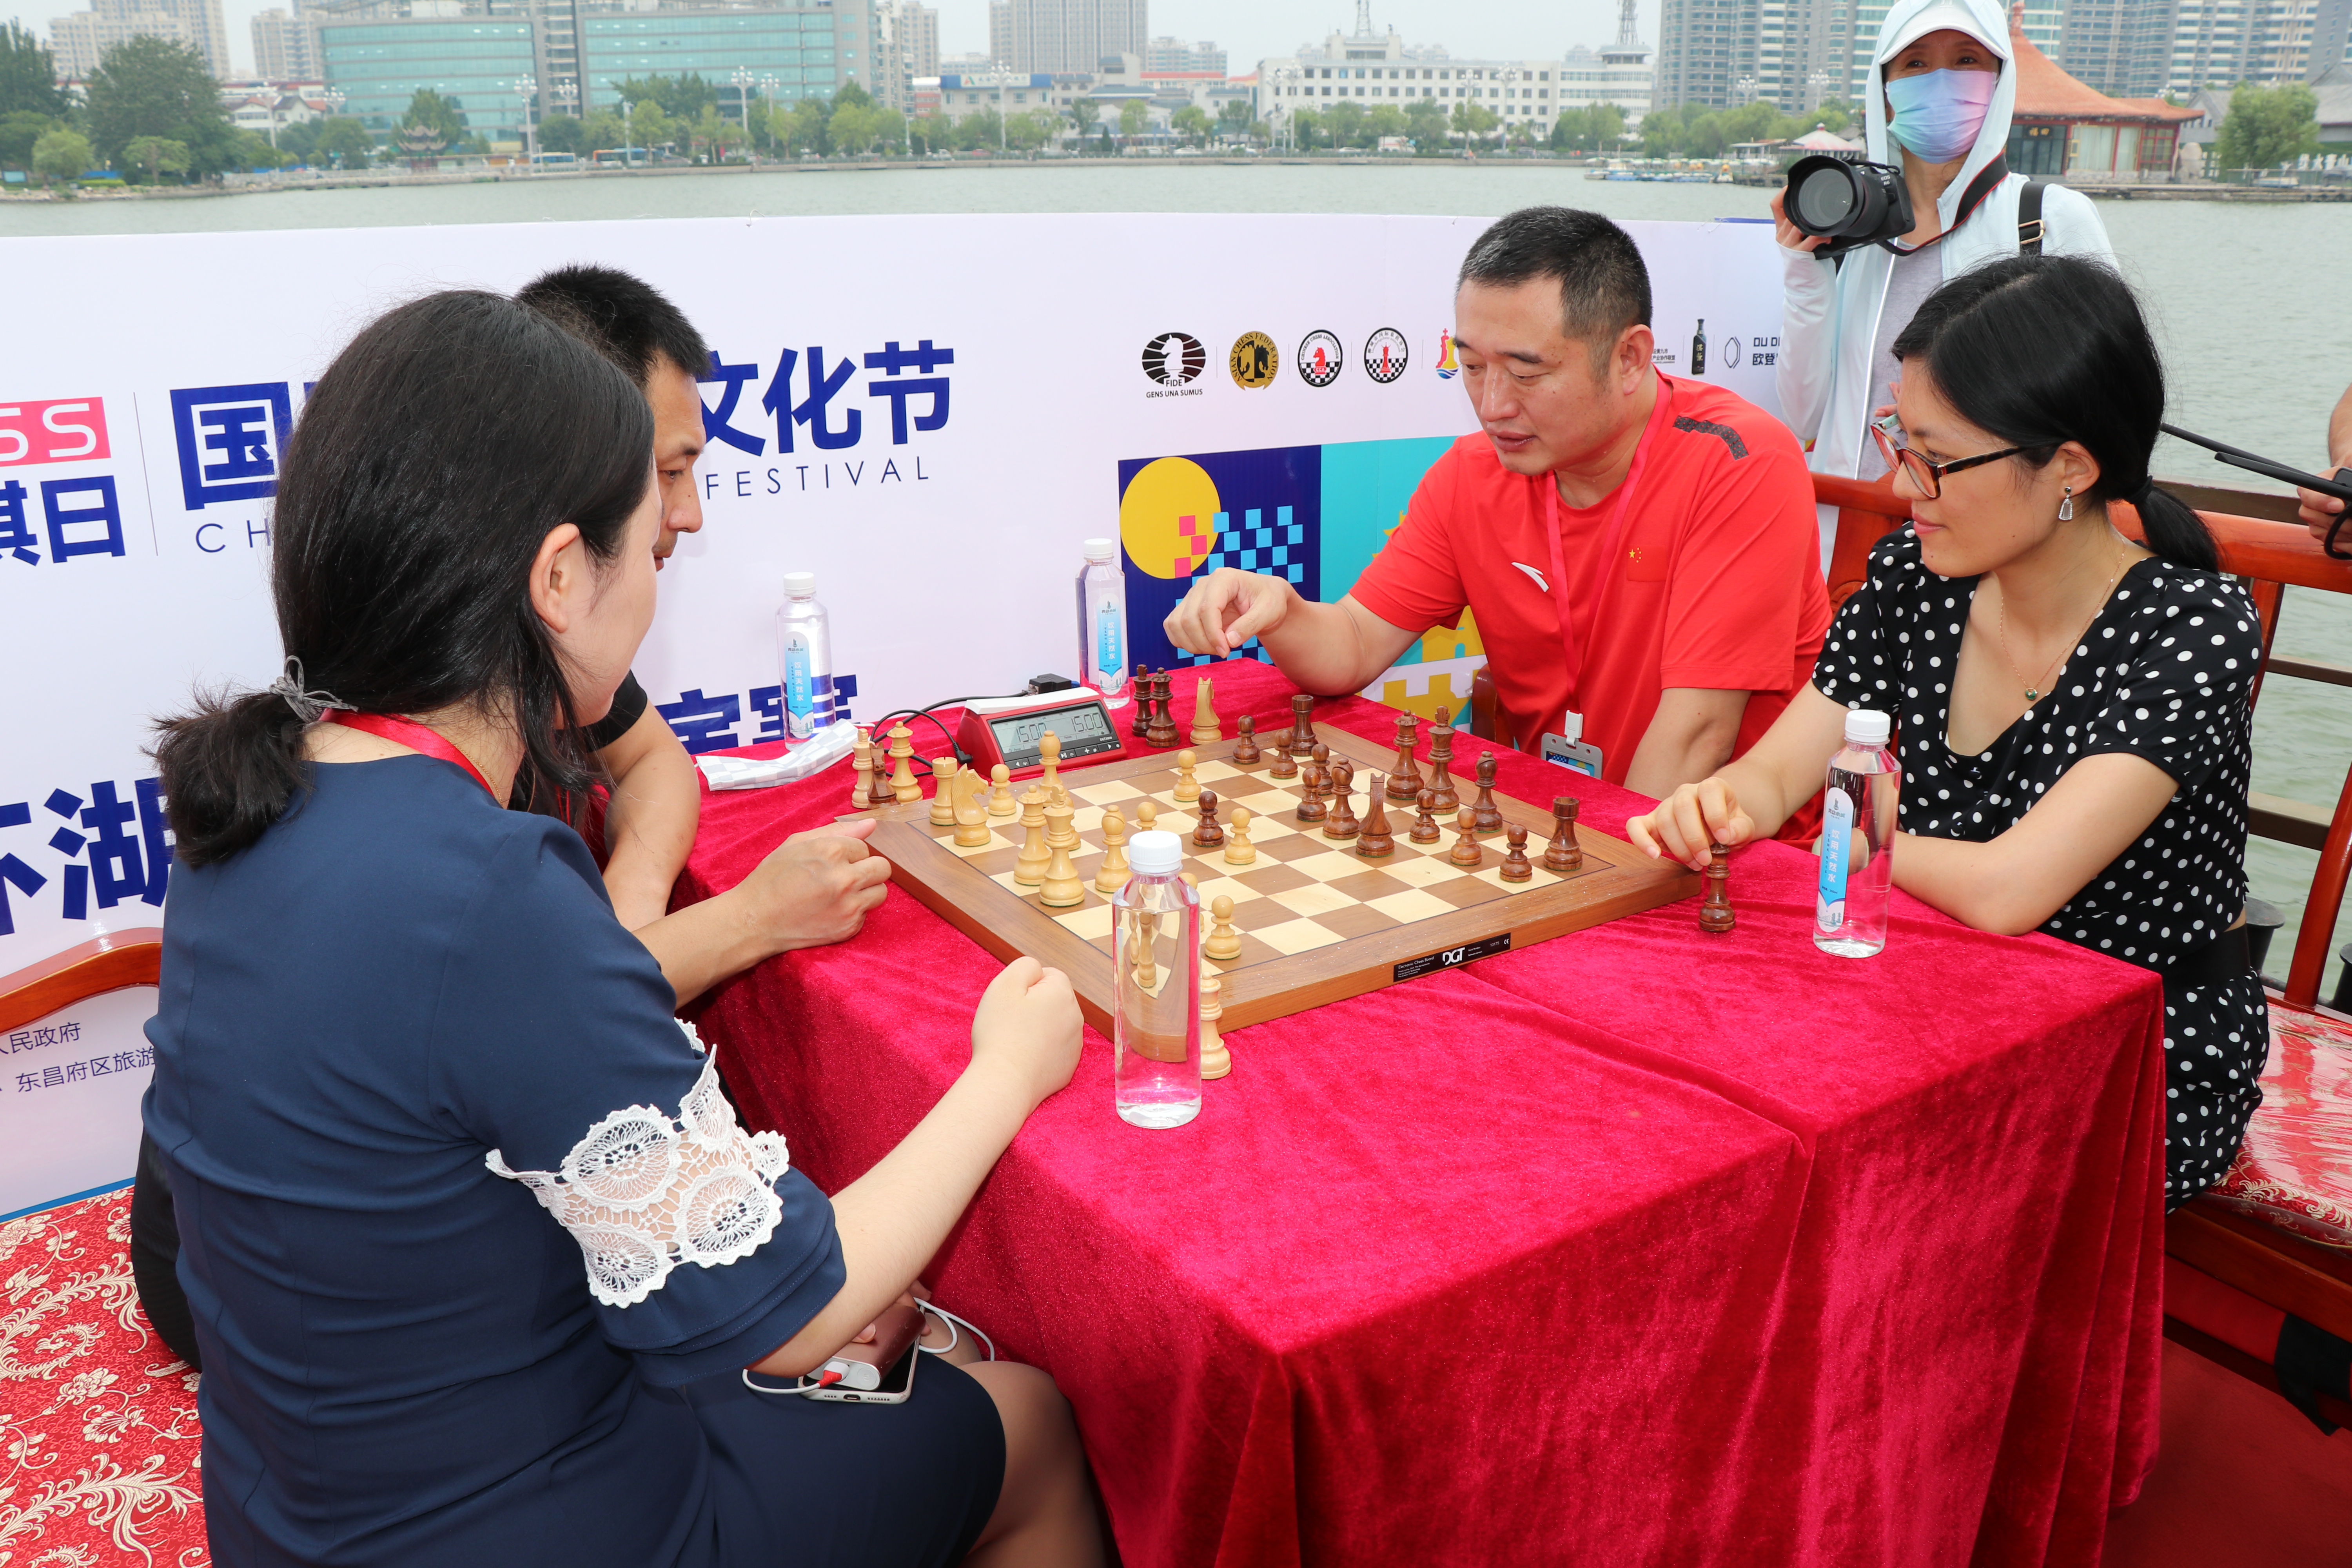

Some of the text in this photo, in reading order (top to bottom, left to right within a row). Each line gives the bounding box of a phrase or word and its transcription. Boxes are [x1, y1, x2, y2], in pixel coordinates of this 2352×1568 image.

[1231, 332, 1277, 381] ASIAN CHESS FEDERATION
[1301, 340, 1310, 360] CHINESE
[1323, 335, 1339, 359] ASSOCIATION
[1753, 353, 1778, 365] 欧登
[696, 340, 954, 457] 文化节
[706, 456, 929, 500] FESTIVAL
[794, 661, 804, 701] 饮用天然水
[1071, 713, 1103, 732] 15.00
[1828, 829, 1840, 883] 饮用天然水
[1442, 947, 1465, 965] DGT
[16, 1045, 156, 1093] 东昌府区旅游
